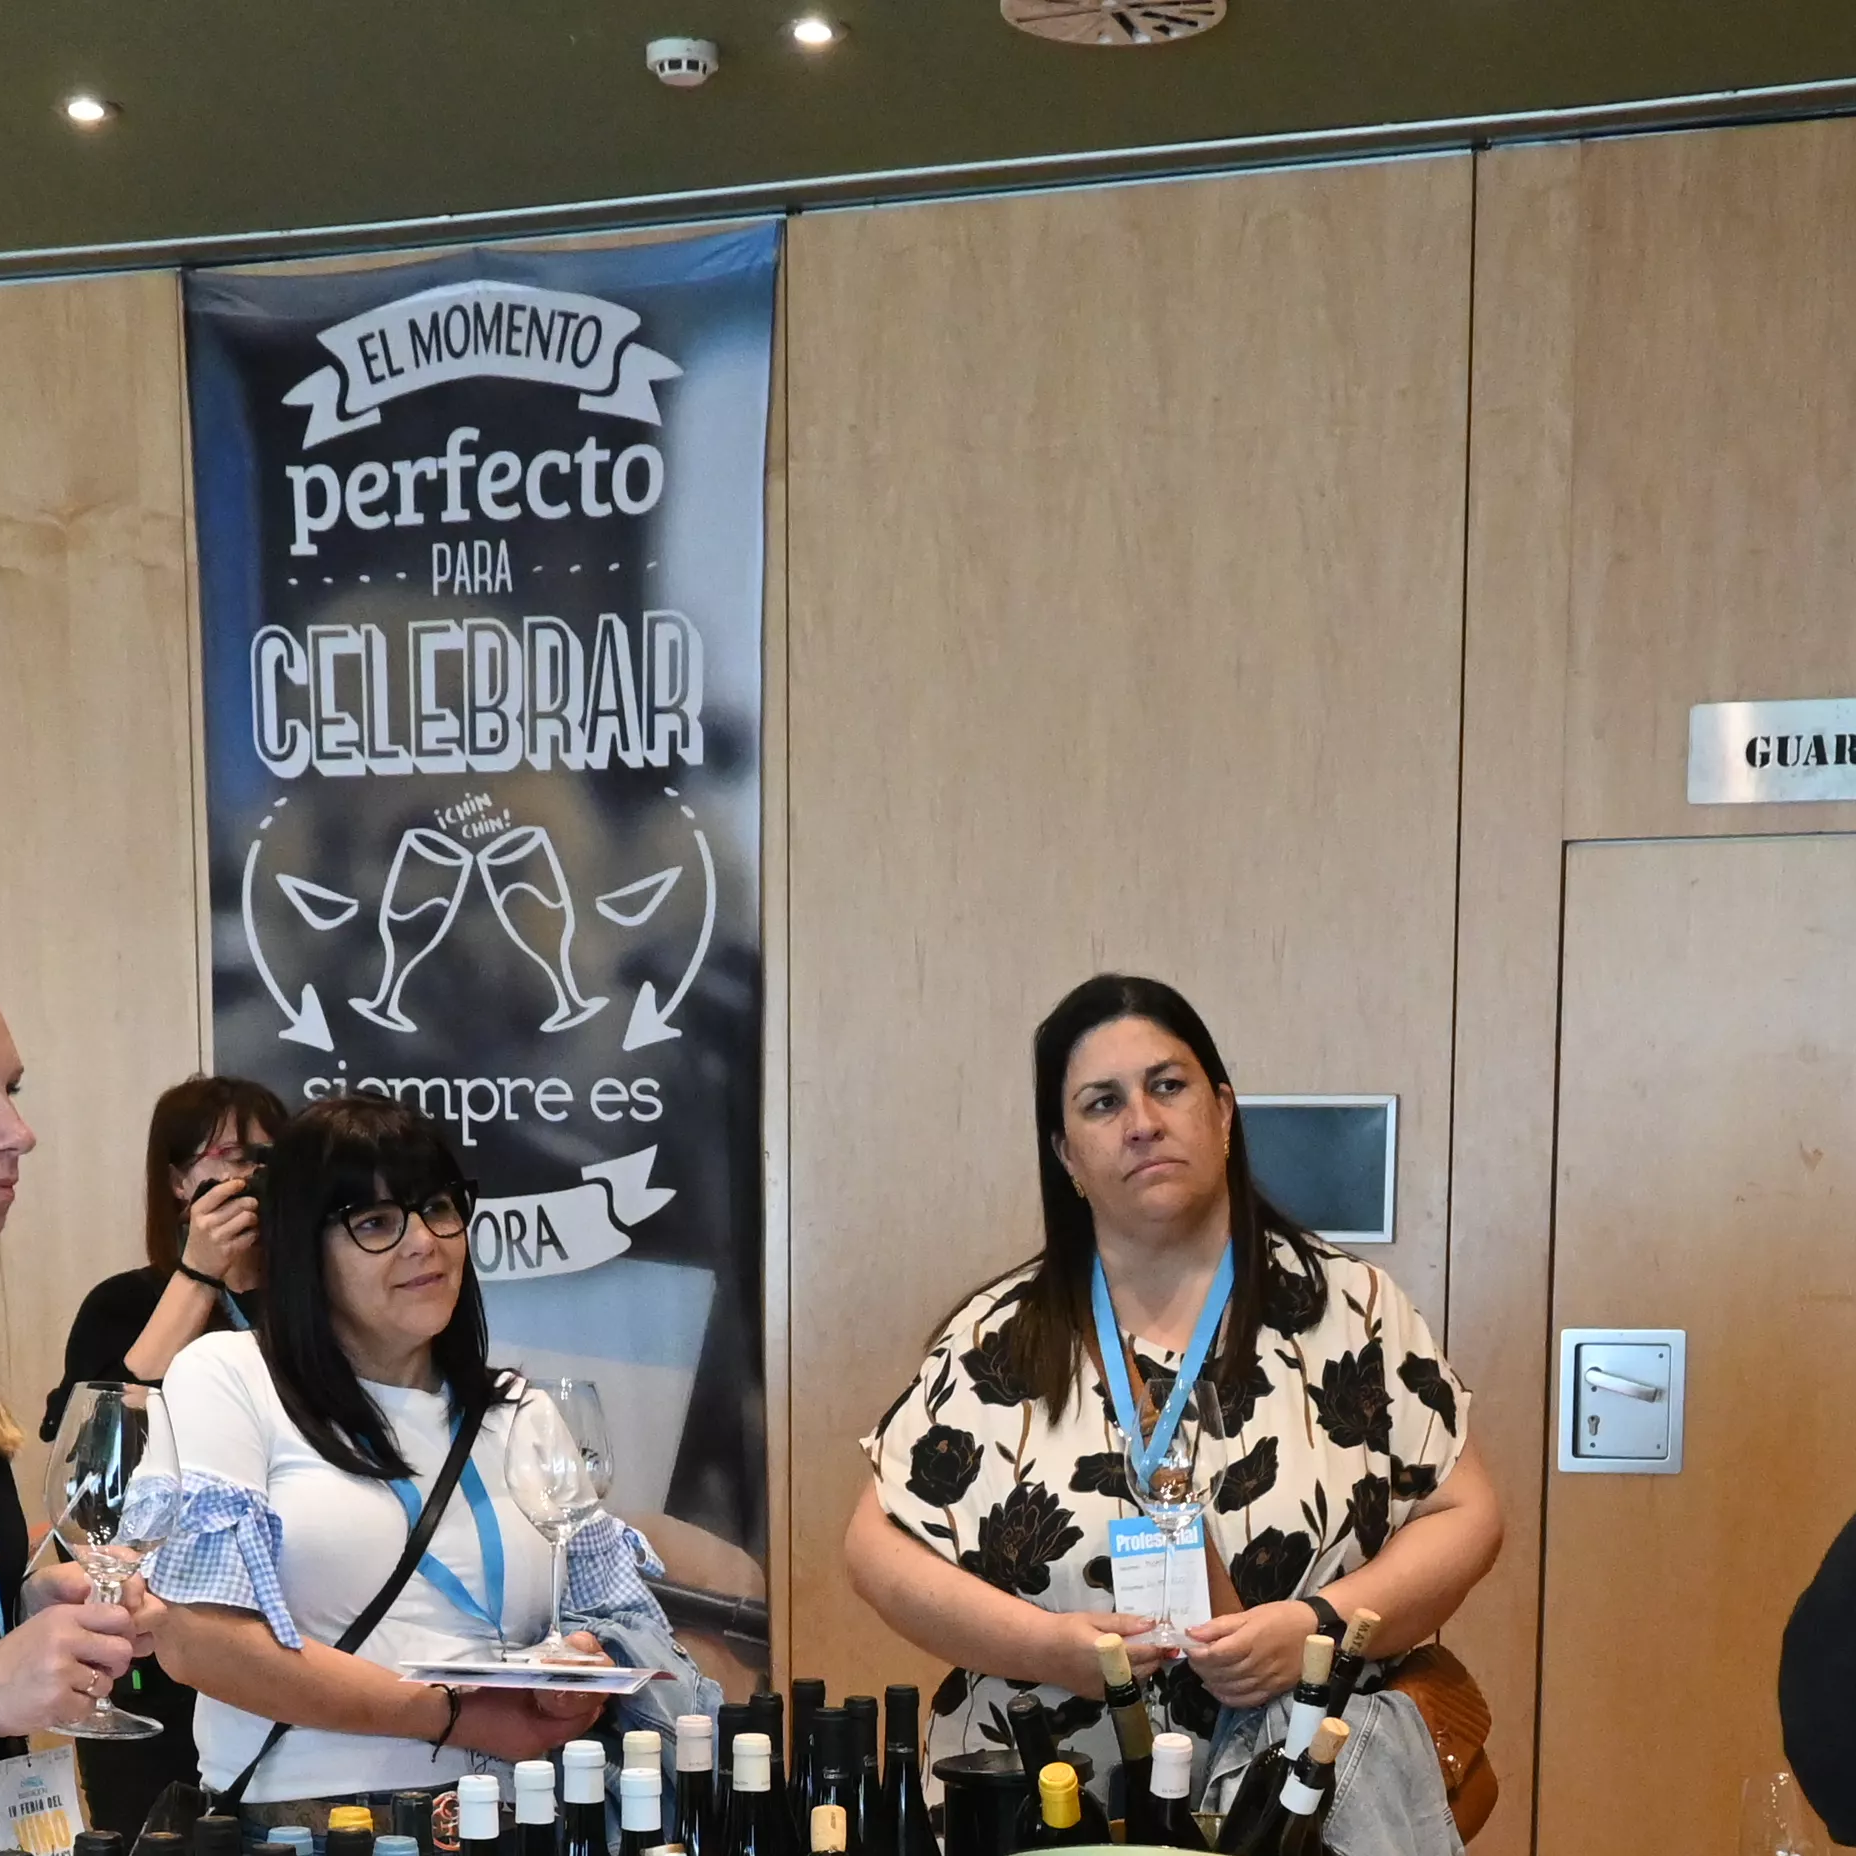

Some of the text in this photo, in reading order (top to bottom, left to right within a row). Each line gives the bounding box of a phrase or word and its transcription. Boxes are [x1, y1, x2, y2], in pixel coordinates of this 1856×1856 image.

[357, 301, 603, 386] EL MOMENTO
[284, 426, 665, 556] perfecto
[431, 538, 514, 596] PARA
[250, 609, 705, 778] CELEBRAR
[590, 1076, 664, 1123] es
[470, 1204, 570, 1274] ORA
